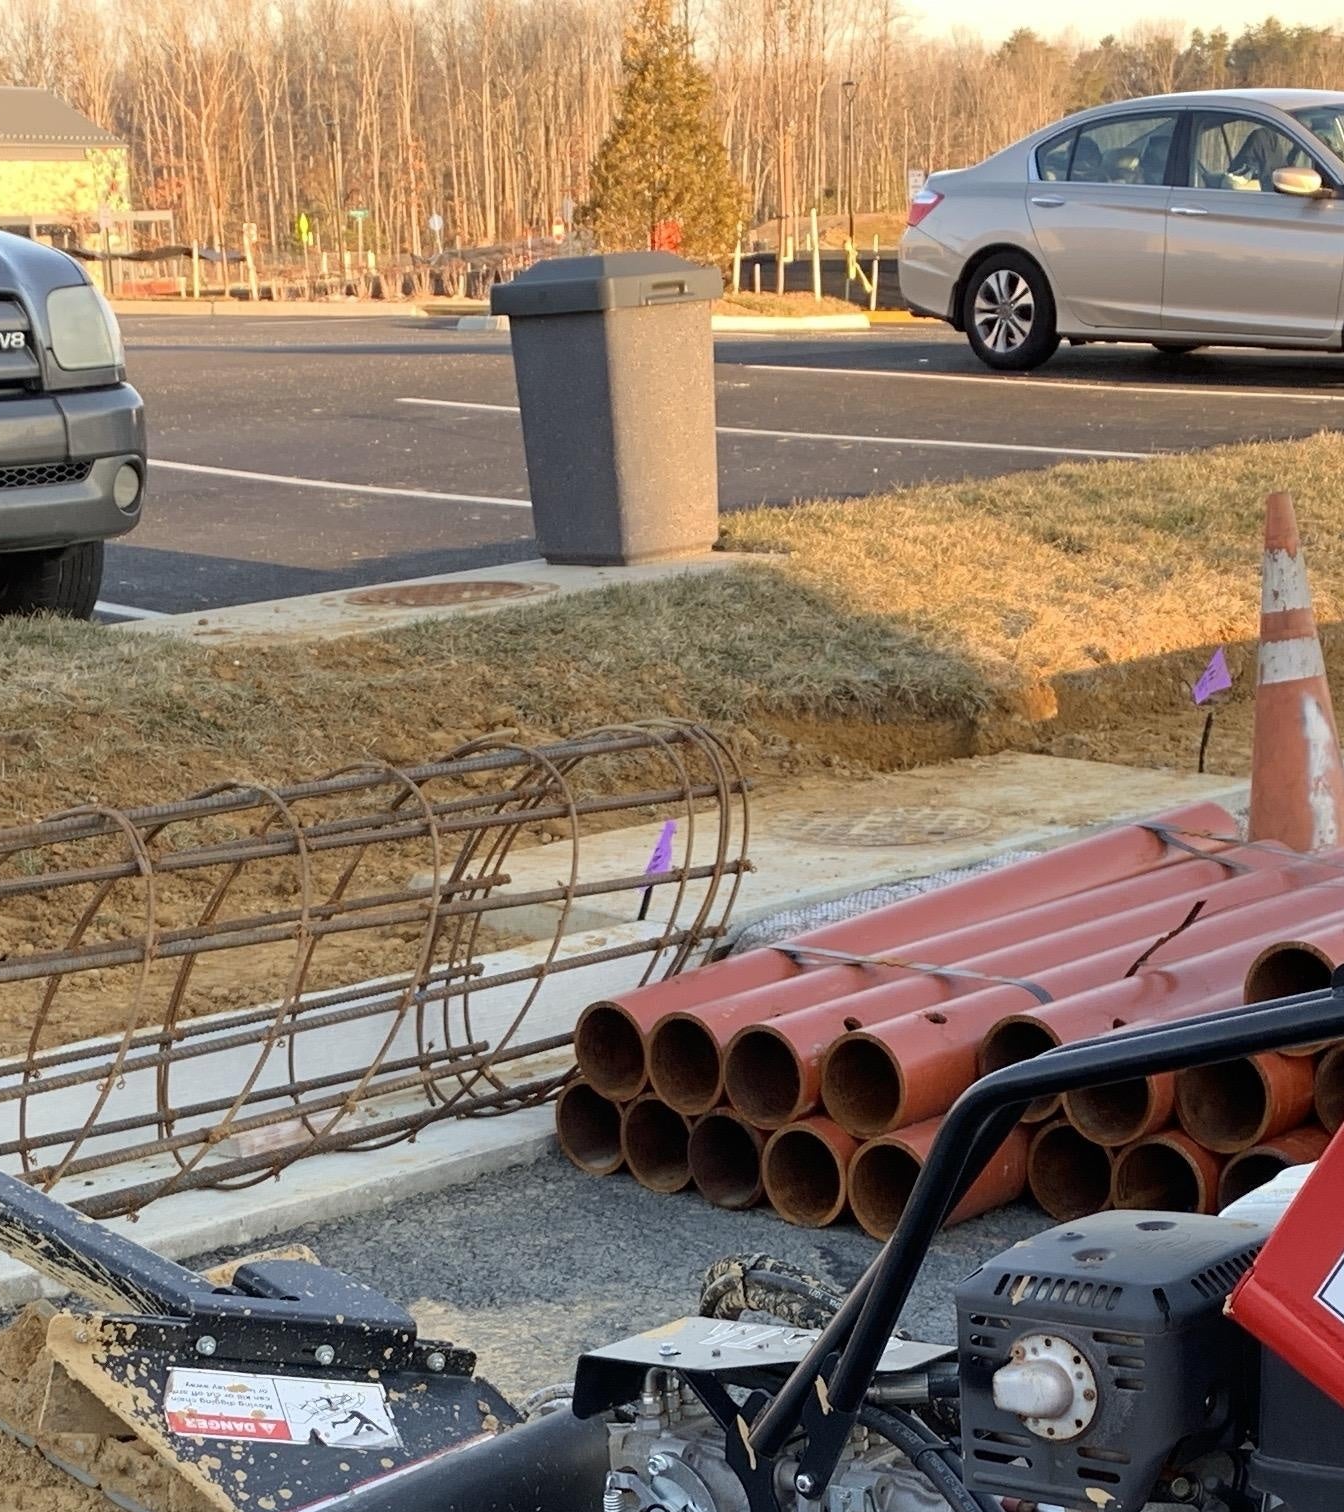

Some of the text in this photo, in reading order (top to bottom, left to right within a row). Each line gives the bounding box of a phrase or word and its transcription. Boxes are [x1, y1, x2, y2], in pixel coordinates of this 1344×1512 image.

[199, 1396, 236, 1408] digging
[238, 1400, 273, 1411] Moving
[183, 1417, 255, 1434] DANGER
